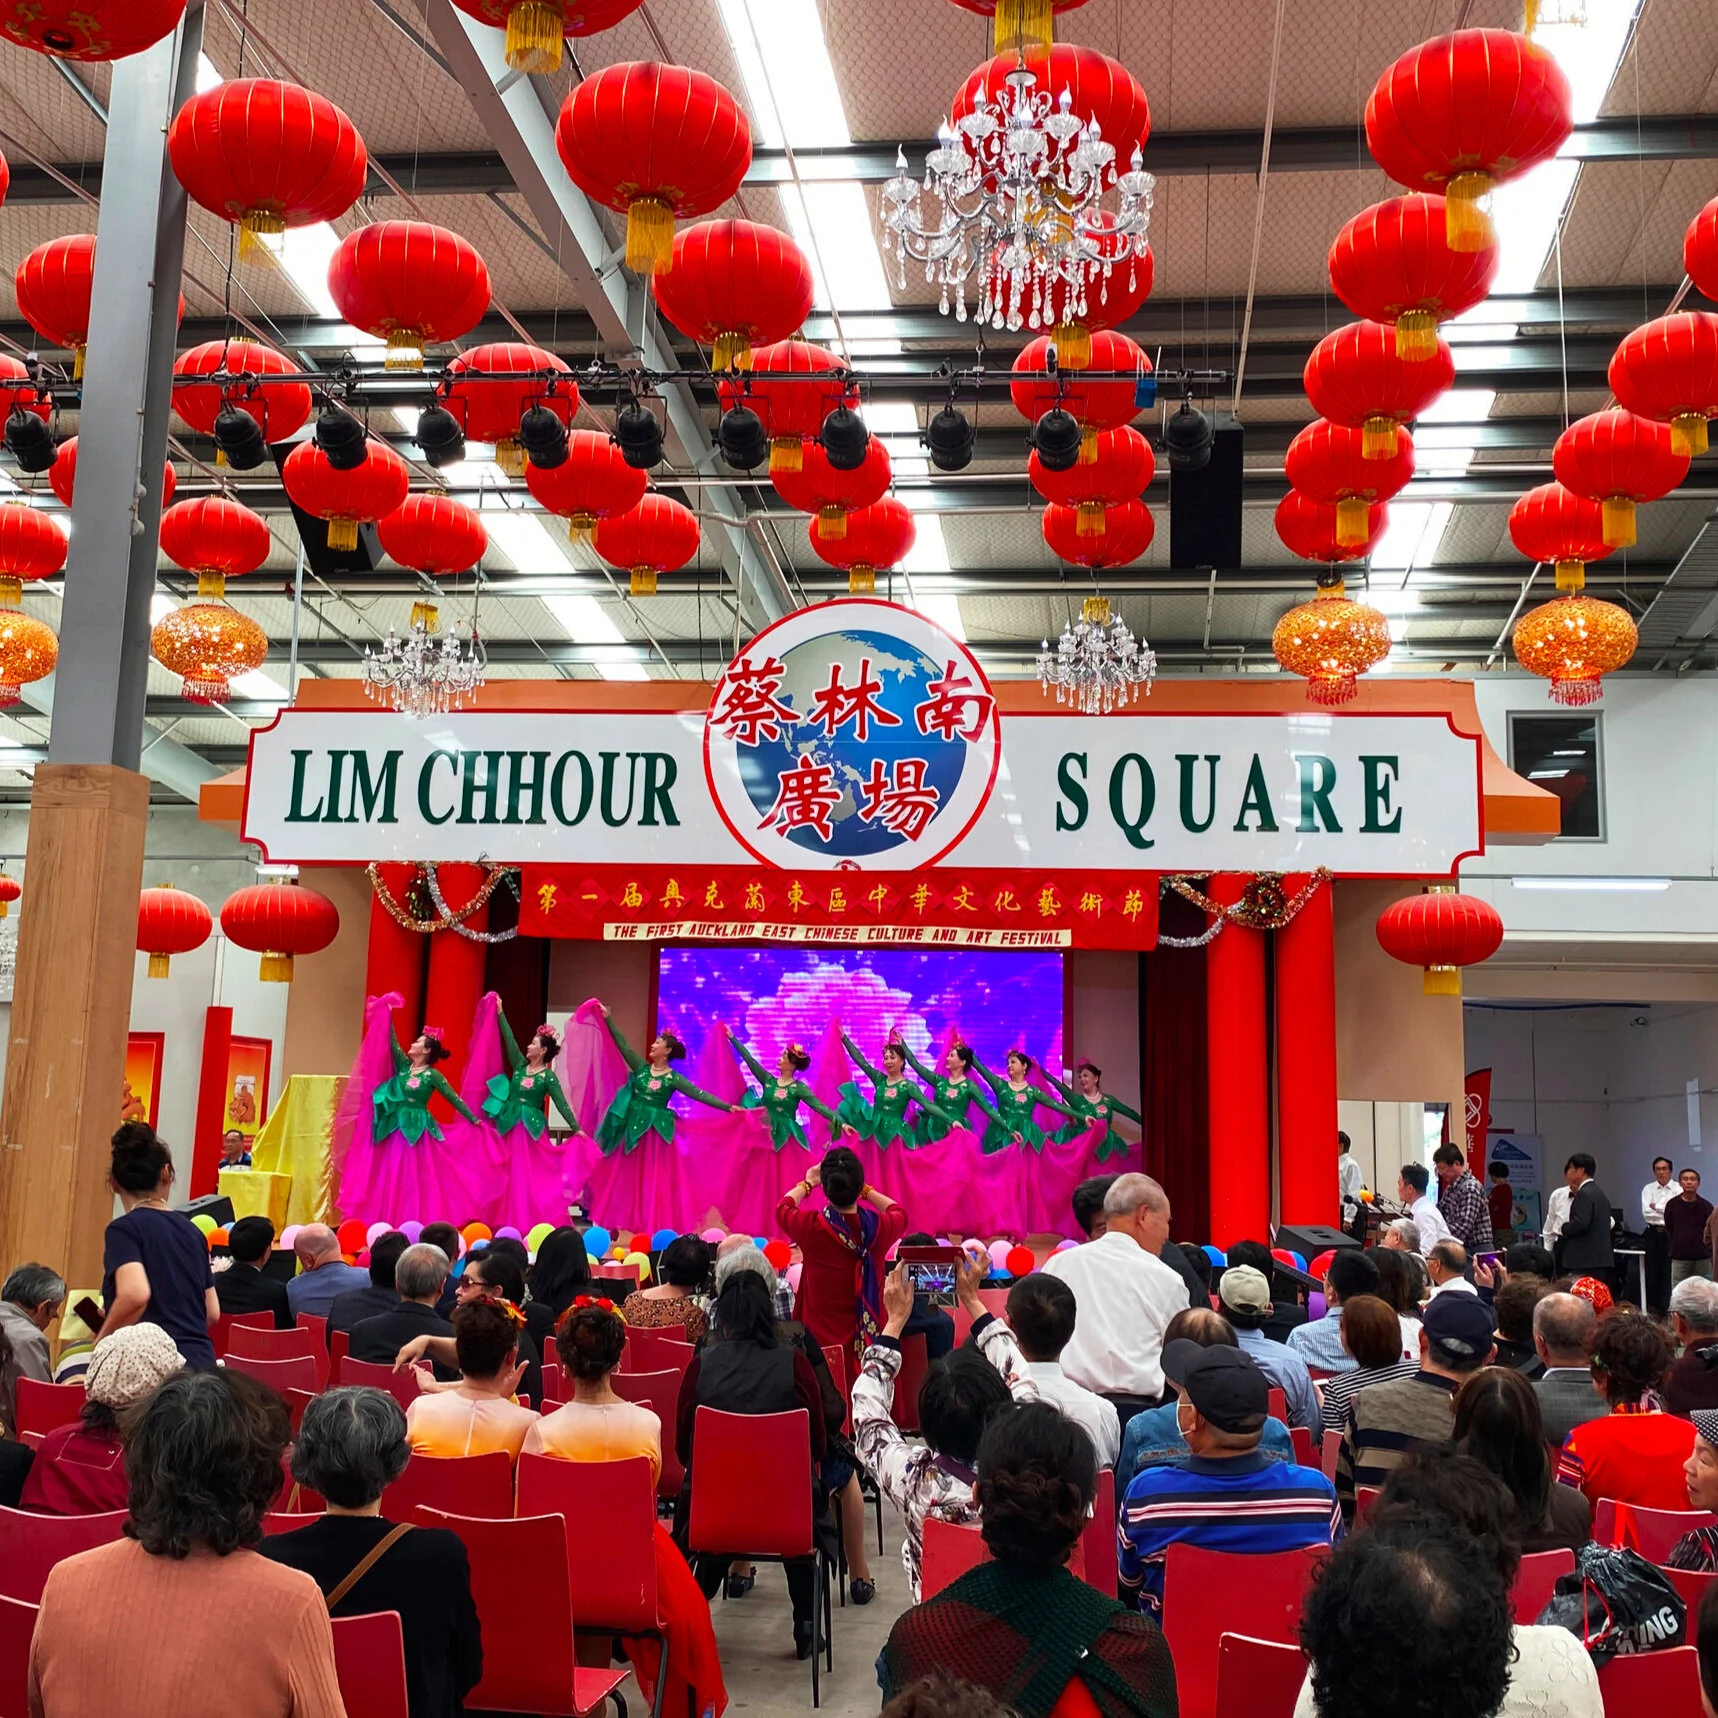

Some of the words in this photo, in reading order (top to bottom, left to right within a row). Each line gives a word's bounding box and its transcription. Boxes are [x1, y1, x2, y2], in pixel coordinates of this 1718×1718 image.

[709, 656, 994, 746] 蔡林南
[284, 749, 399, 824] LIM
[417, 749, 681, 827] CHHOUR
[1056, 752, 1402, 850] SQUARE
[757, 755, 940, 843] 廣場
[613, 925, 638, 938] THE
[689, 923, 755, 938] AUCKLAND
[762, 925, 796, 939] EAST
[867, 927, 924, 942] CULTURE
[932, 929, 957, 943] AND
[966, 931, 993, 945] ART
